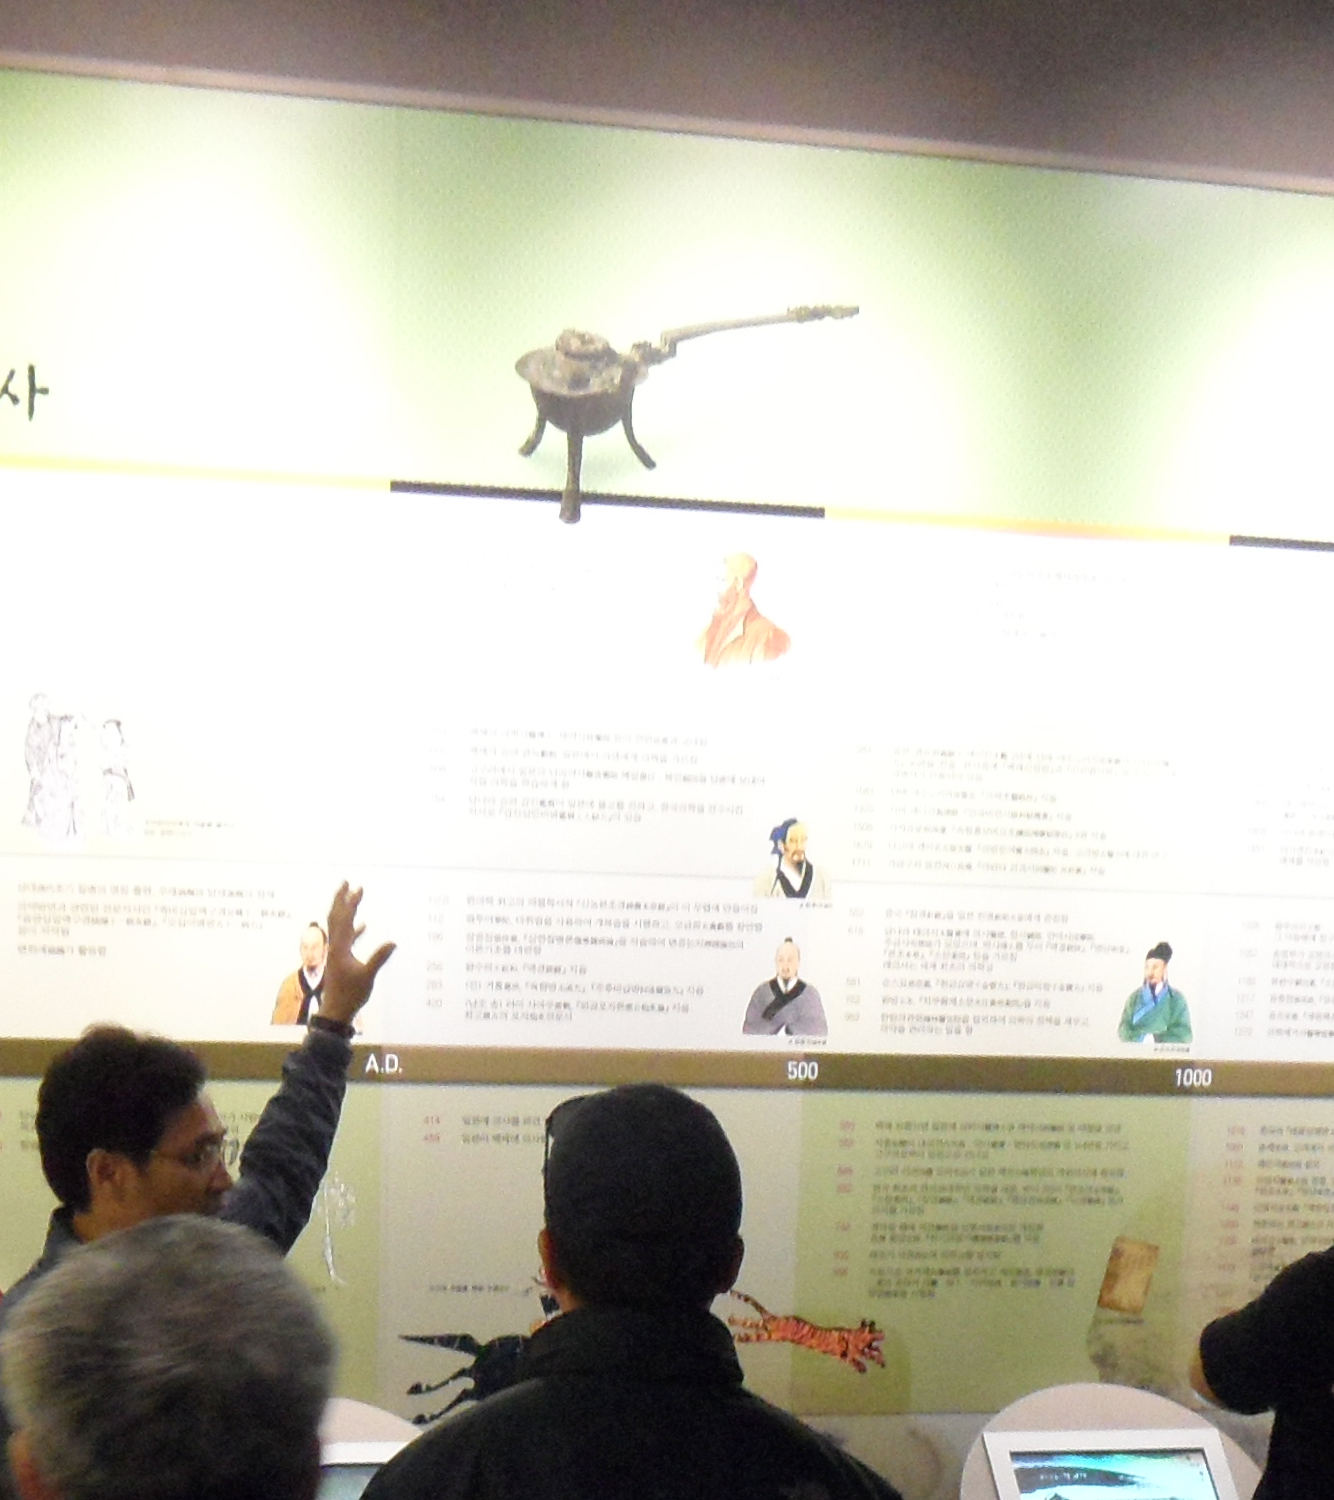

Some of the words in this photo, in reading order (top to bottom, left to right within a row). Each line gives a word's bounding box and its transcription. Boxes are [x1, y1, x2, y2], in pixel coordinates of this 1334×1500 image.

[364, 1051, 403, 1074] A.D.
[787, 1060, 819, 1081] 500
[1175, 1067, 1212, 1088] 1000
